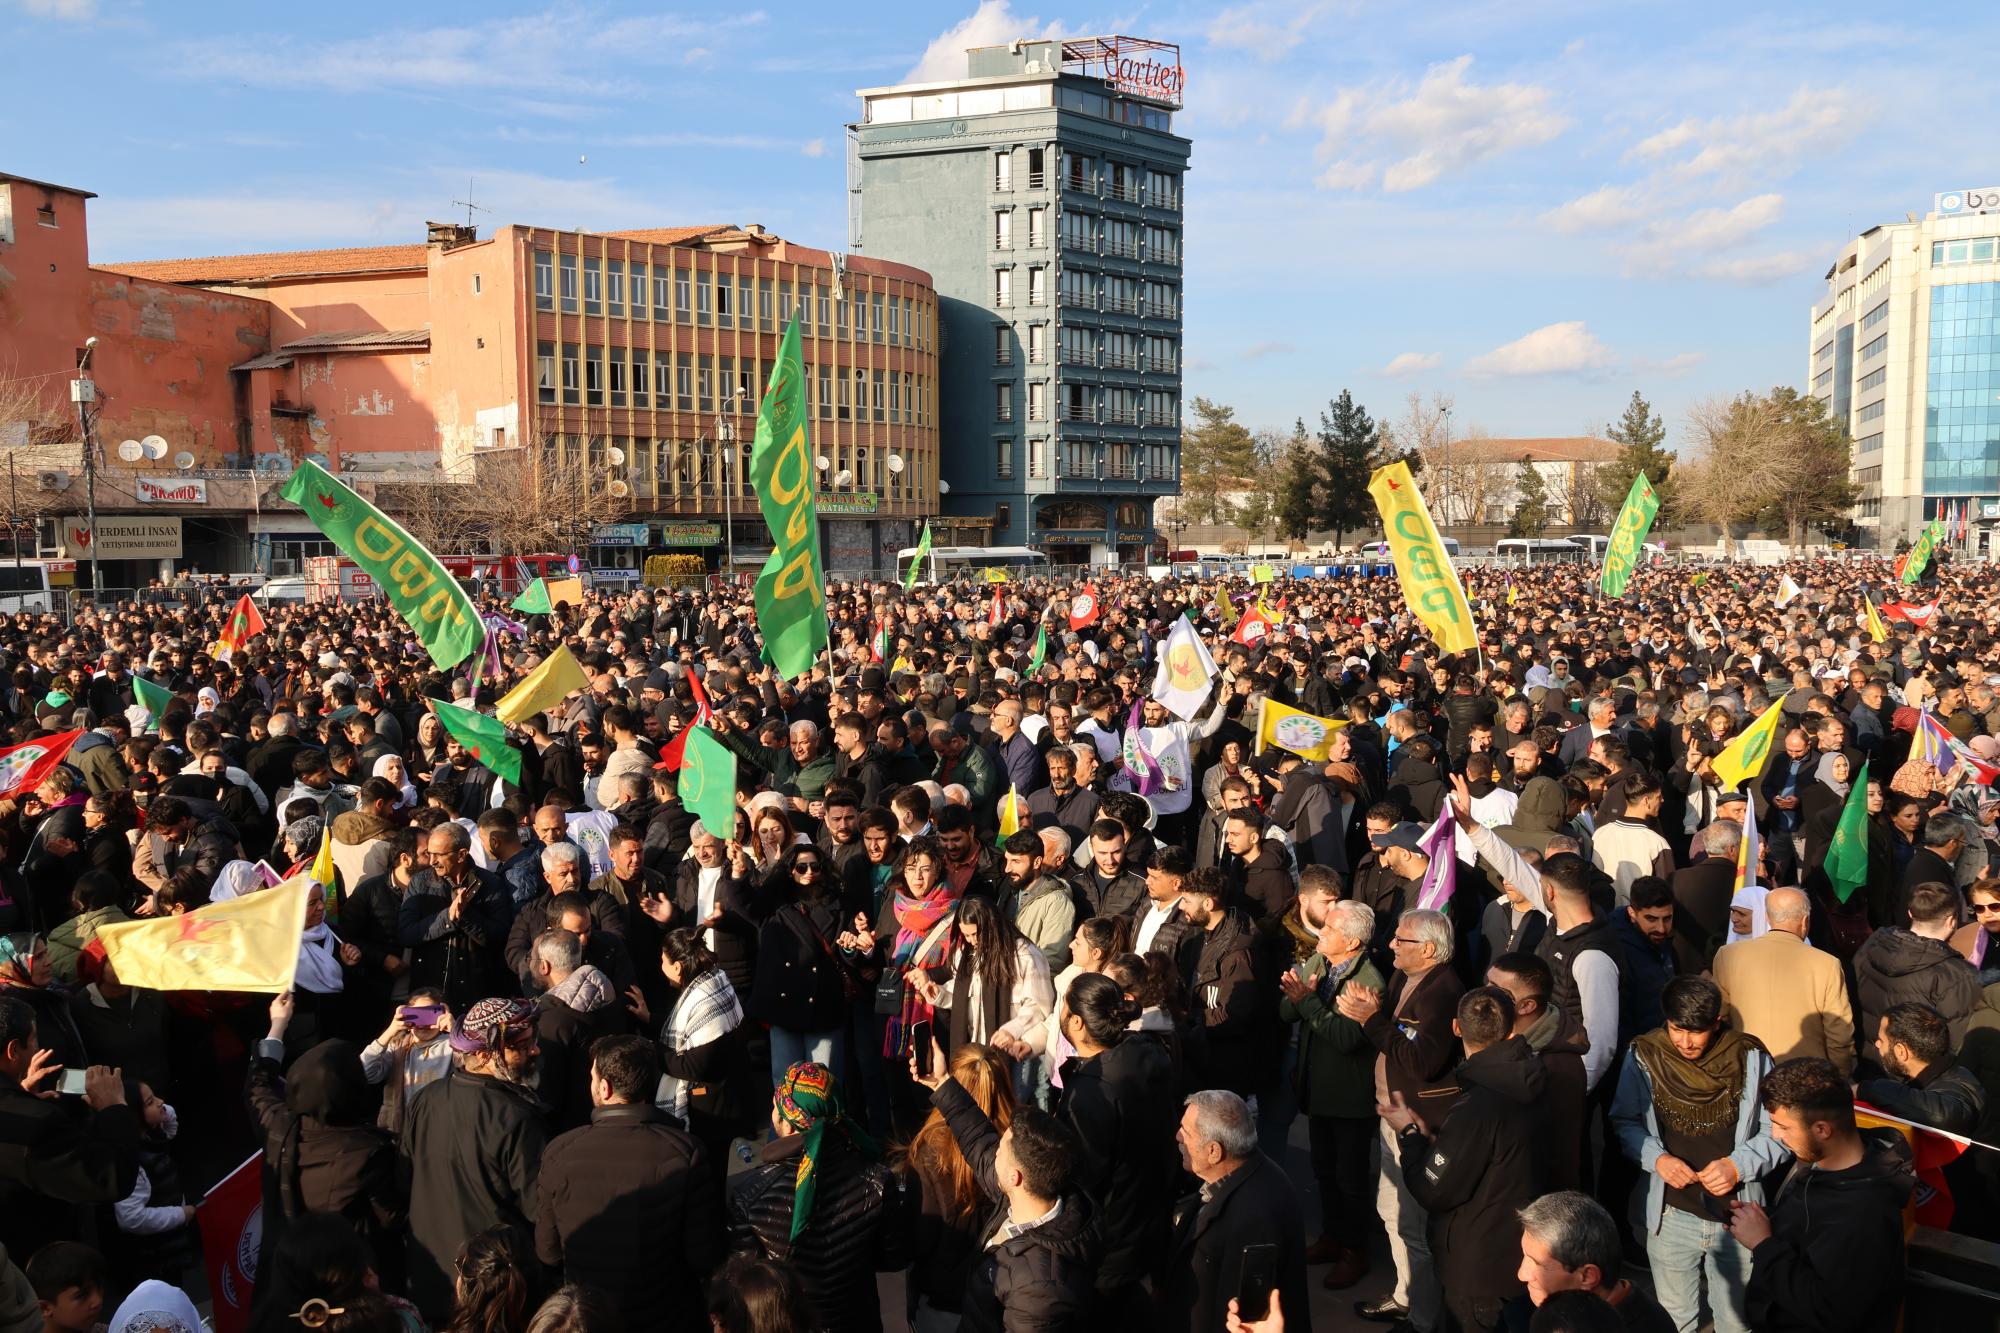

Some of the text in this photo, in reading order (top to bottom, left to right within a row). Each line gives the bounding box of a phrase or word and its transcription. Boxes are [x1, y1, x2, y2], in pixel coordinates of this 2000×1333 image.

[1104, 47, 1183, 92] Cartier
[100, 525, 178, 537] ERDEMLİ İNSAN
[672, 525, 713, 536] BAHAR
[101, 539, 177, 550] YETİŞTİRME DERNEĞİ
[354, 515, 466, 626] DBP
[1395, 510, 1460, 624] DBP
[354, 575, 368, 584] 112
